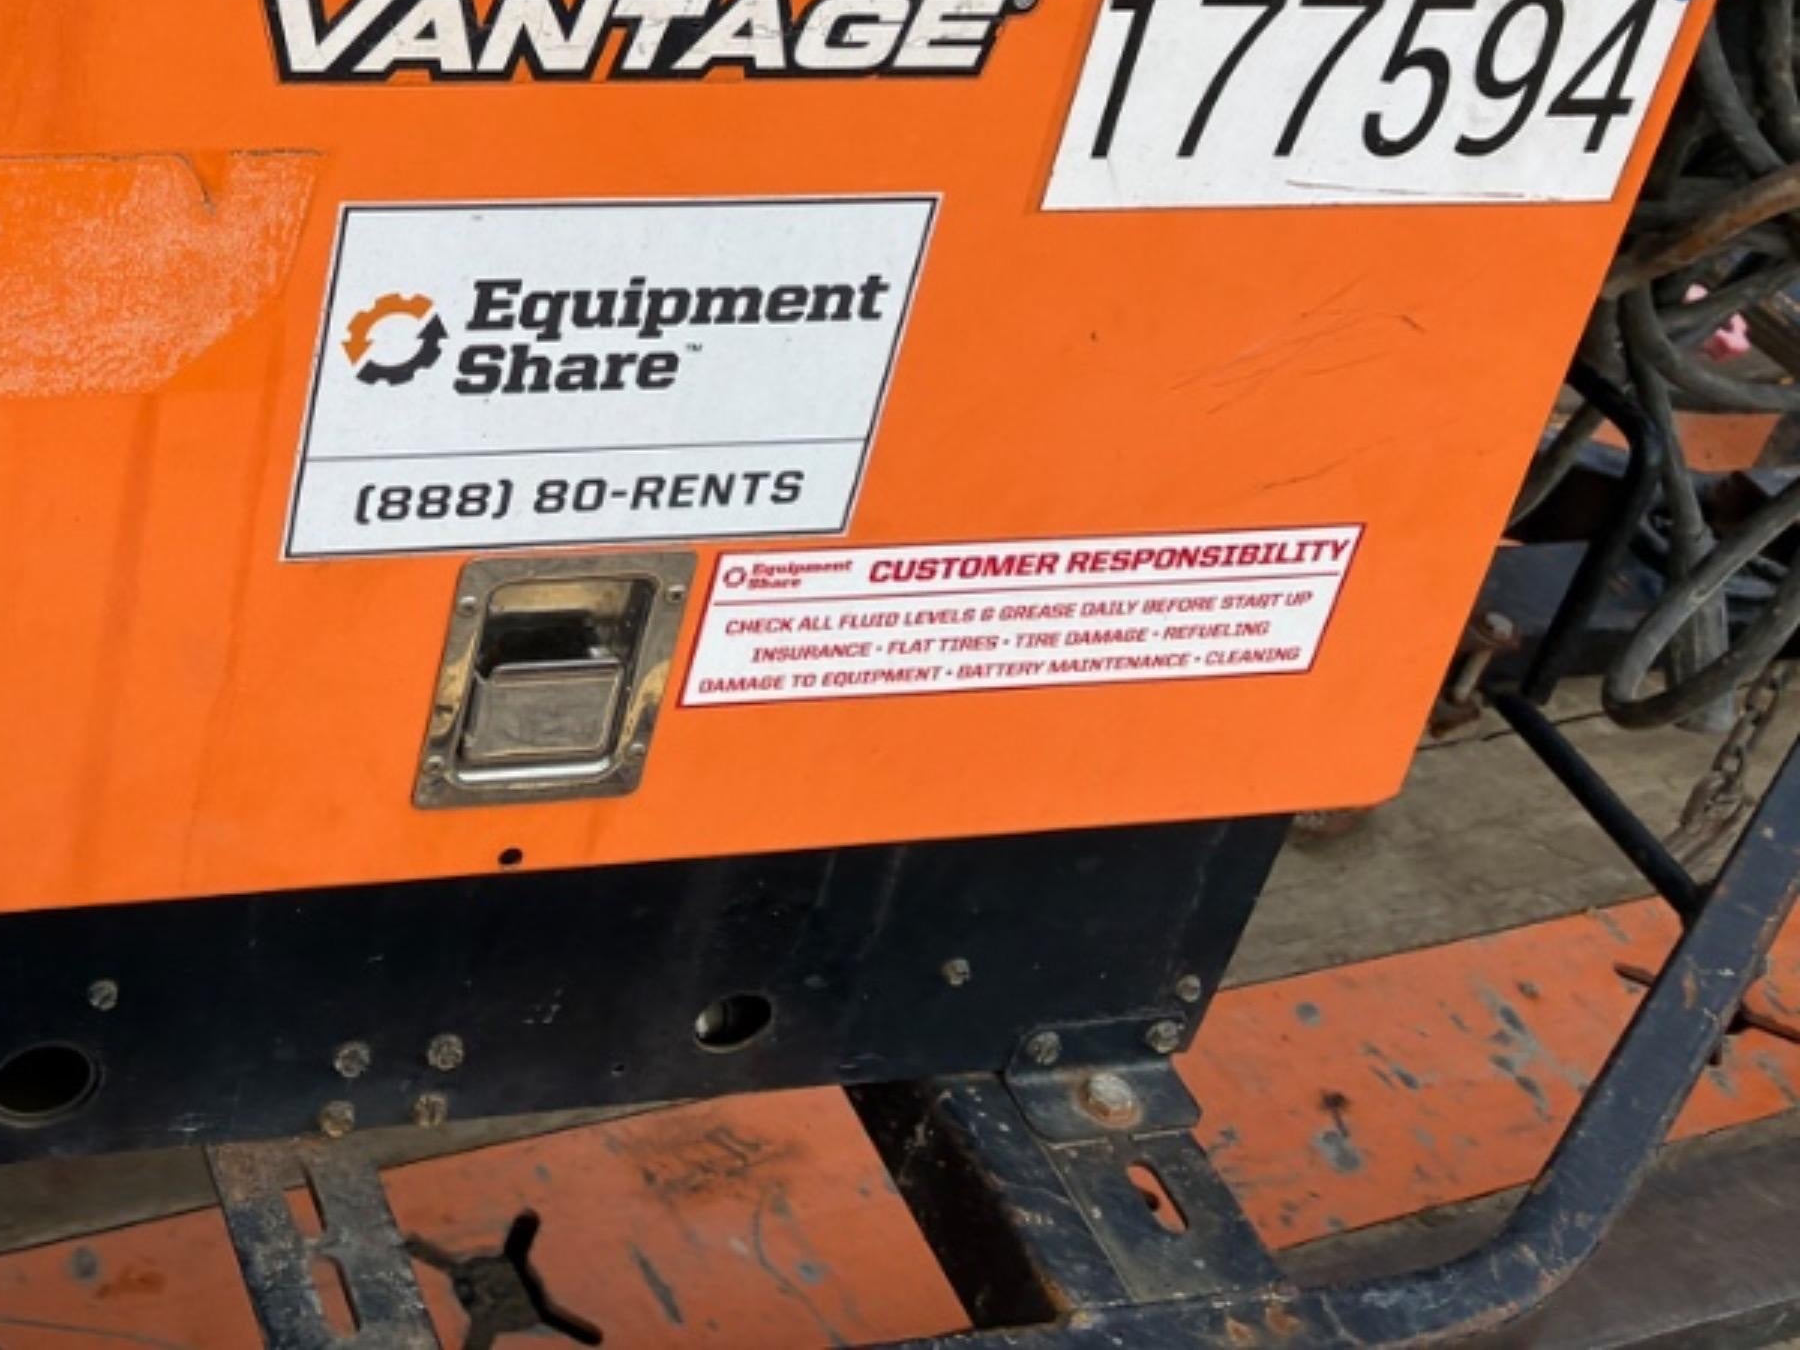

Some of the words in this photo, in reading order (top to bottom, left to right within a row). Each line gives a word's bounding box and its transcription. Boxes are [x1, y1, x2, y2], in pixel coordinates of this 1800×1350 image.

[465, 273, 891, 342] Equipment
[353, 479, 513, 525] (888)
[533, 470, 805, 515] 80-RENTS
[747, 577, 802, 590] Share
[751, 560, 854, 576] Equipment
[868, 552, 1059, 583] CUSTOMER
[1066, 538, 1351, 575] RESPONSIBILITY
[724, 617, 794, 636] CHECK
[799, 614, 833, 632] ALL
[839, 612, 899, 630] FLUID
[904, 607, 976, 626] LEVELS
[999, 602, 1075, 623] GREASE
[1080, 599, 1139, 618] DAILY
[1142, 596, 1219, 615] BEFORE
[1220, 592, 1284, 610] START
[1285, 590, 1314, 607] UP
[750, 642, 873, 664] INSURANCE
[886, 638, 937, 656] FLAT
[939, 635, 1000, 654] TIRES
[1014, 631, 1059, 649] TIRE
[1064, 626, 1148, 646] DAMAGE
[1162, 620, 1271, 640] REFUELING
[698, 674, 784, 694] DAMAGE
[791, 673, 817, 689] TO
[821, 665, 942, 688] EQUIPMENT
[956, 659, 1047, 680] BATTERY
[1048, 652, 1189, 675] MAINTENANCE
[1204, 646, 1300, 665] CLEANING
